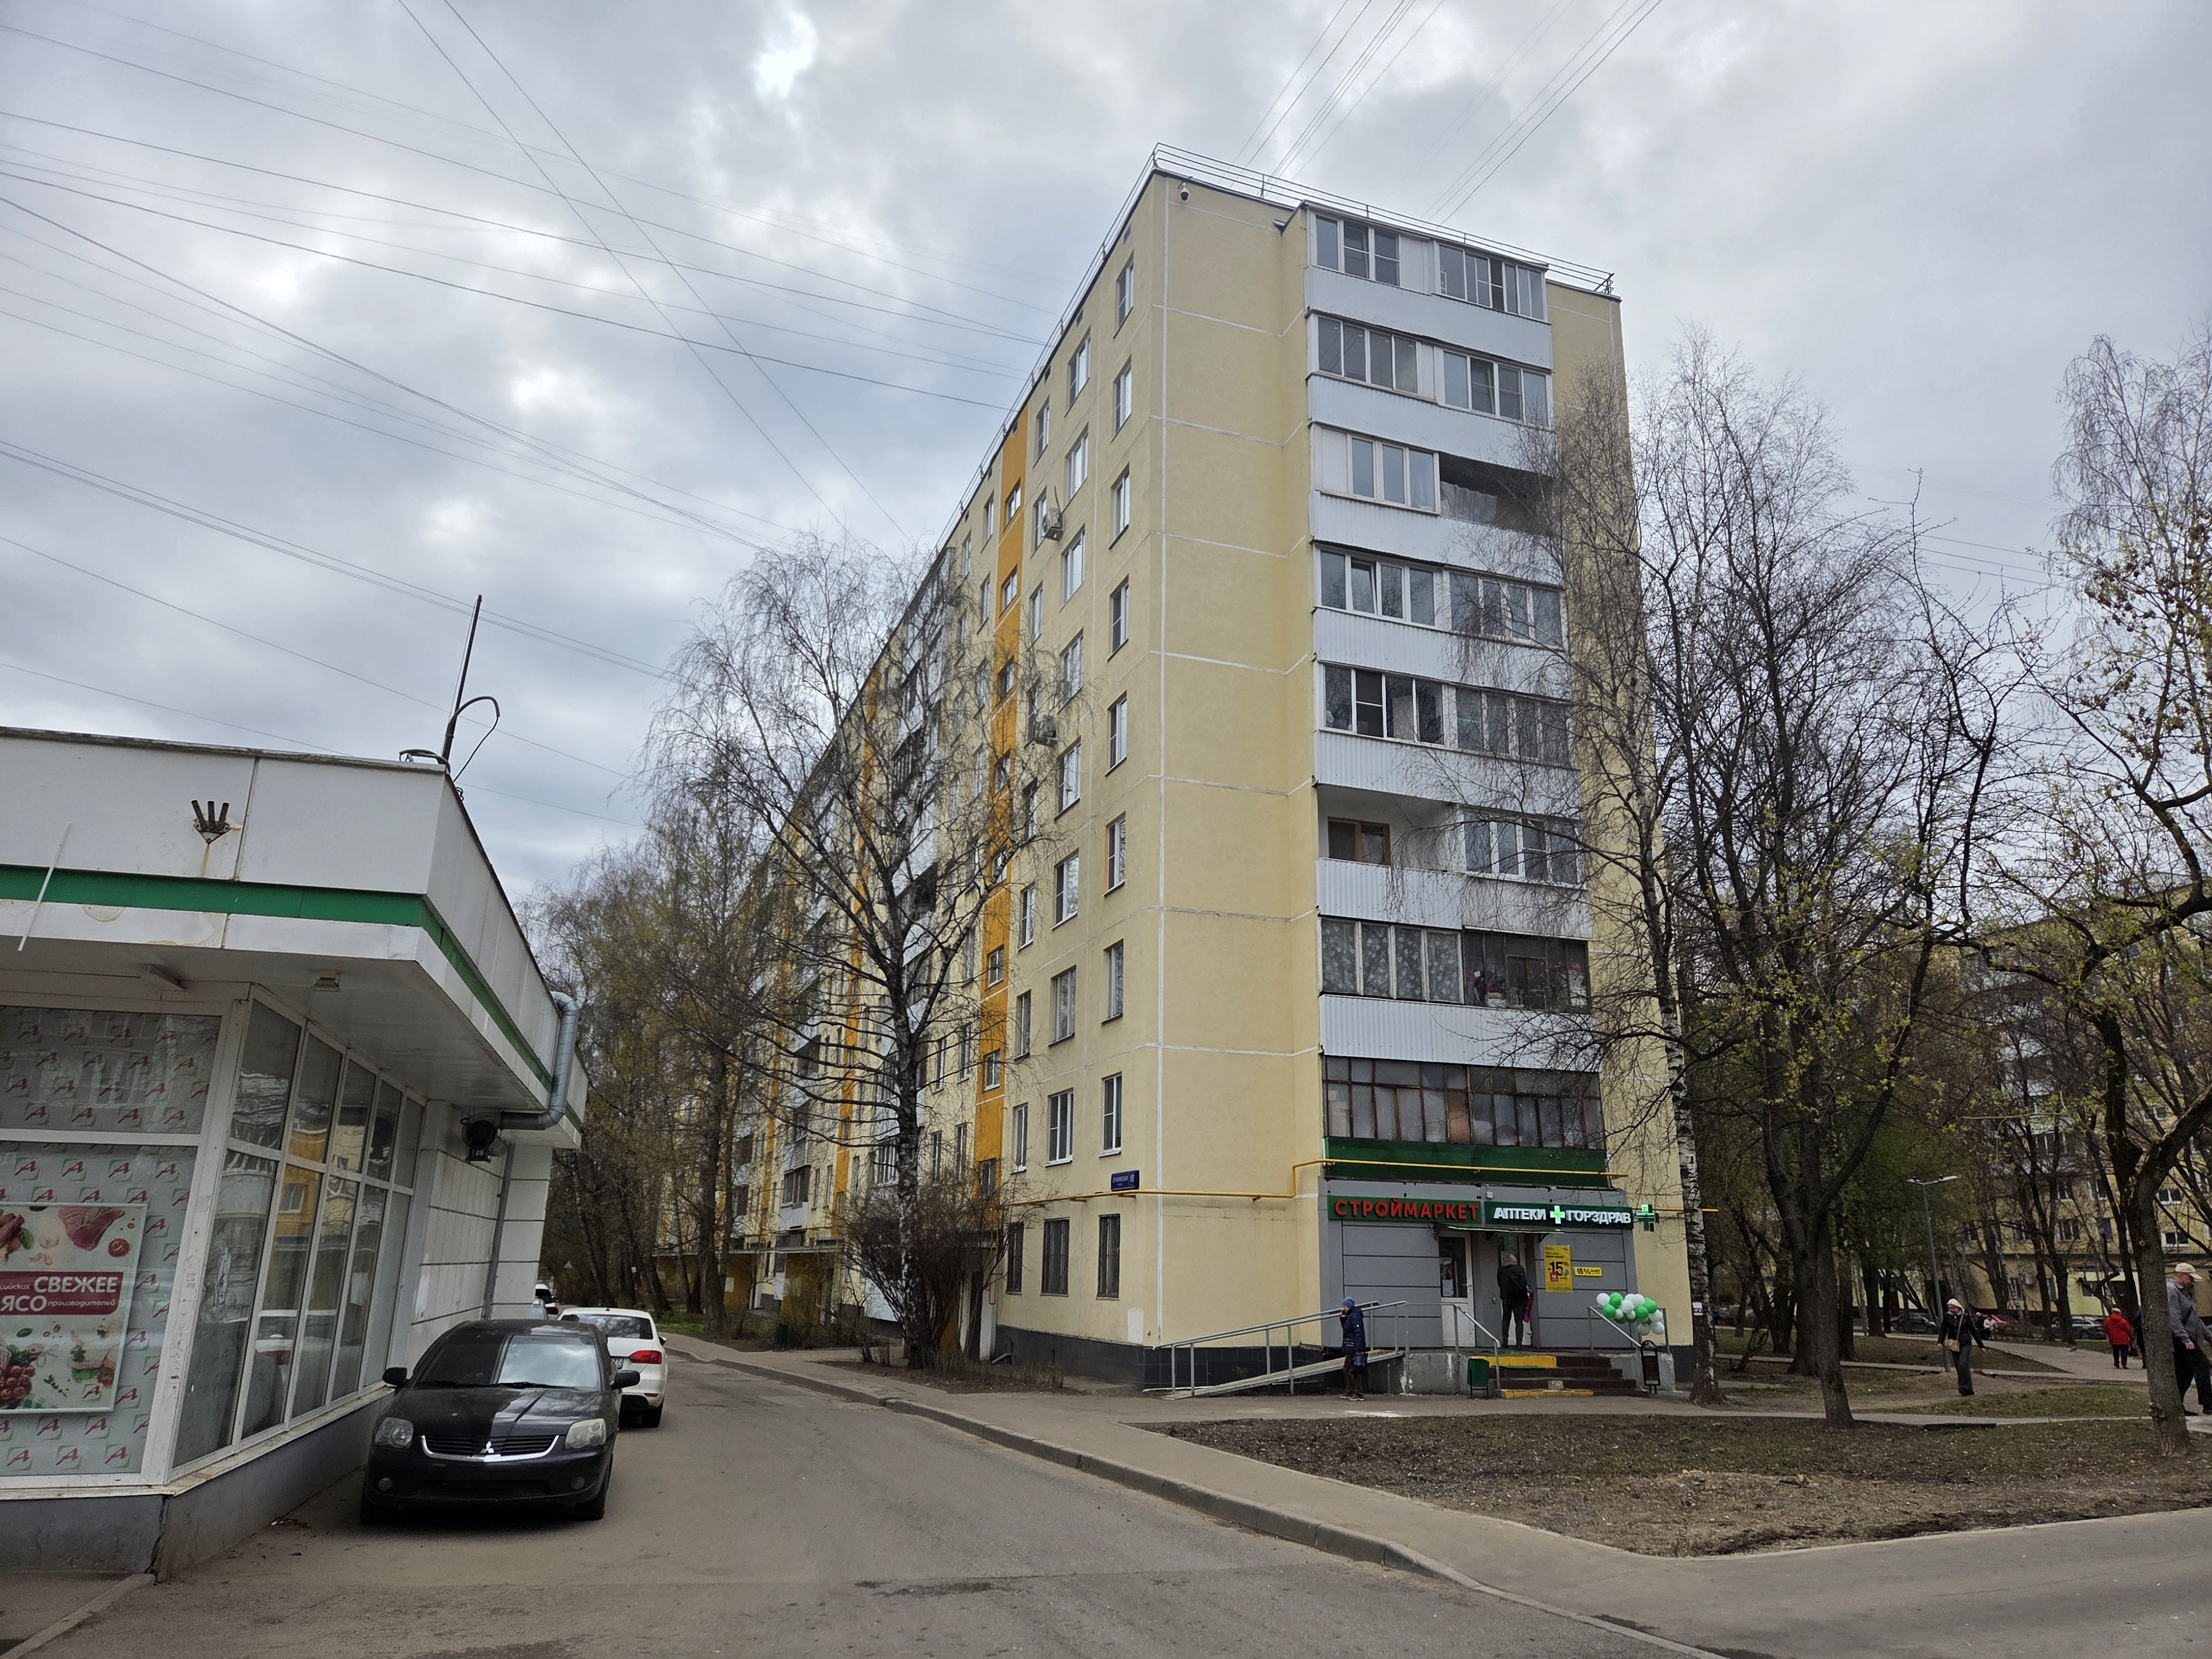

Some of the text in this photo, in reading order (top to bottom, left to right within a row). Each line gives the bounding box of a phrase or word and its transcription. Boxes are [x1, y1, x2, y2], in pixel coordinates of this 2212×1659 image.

[1334, 1198, 1479, 1220] СТРОЙМАРКЕТ
[1494, 1207, 1631, 1224] АПТЕКИ ГОРЗДРАВ
[34, 1276, 118, 1293] СВЕЖЕЕ
[48, 1299, 115, 1308] производителей
